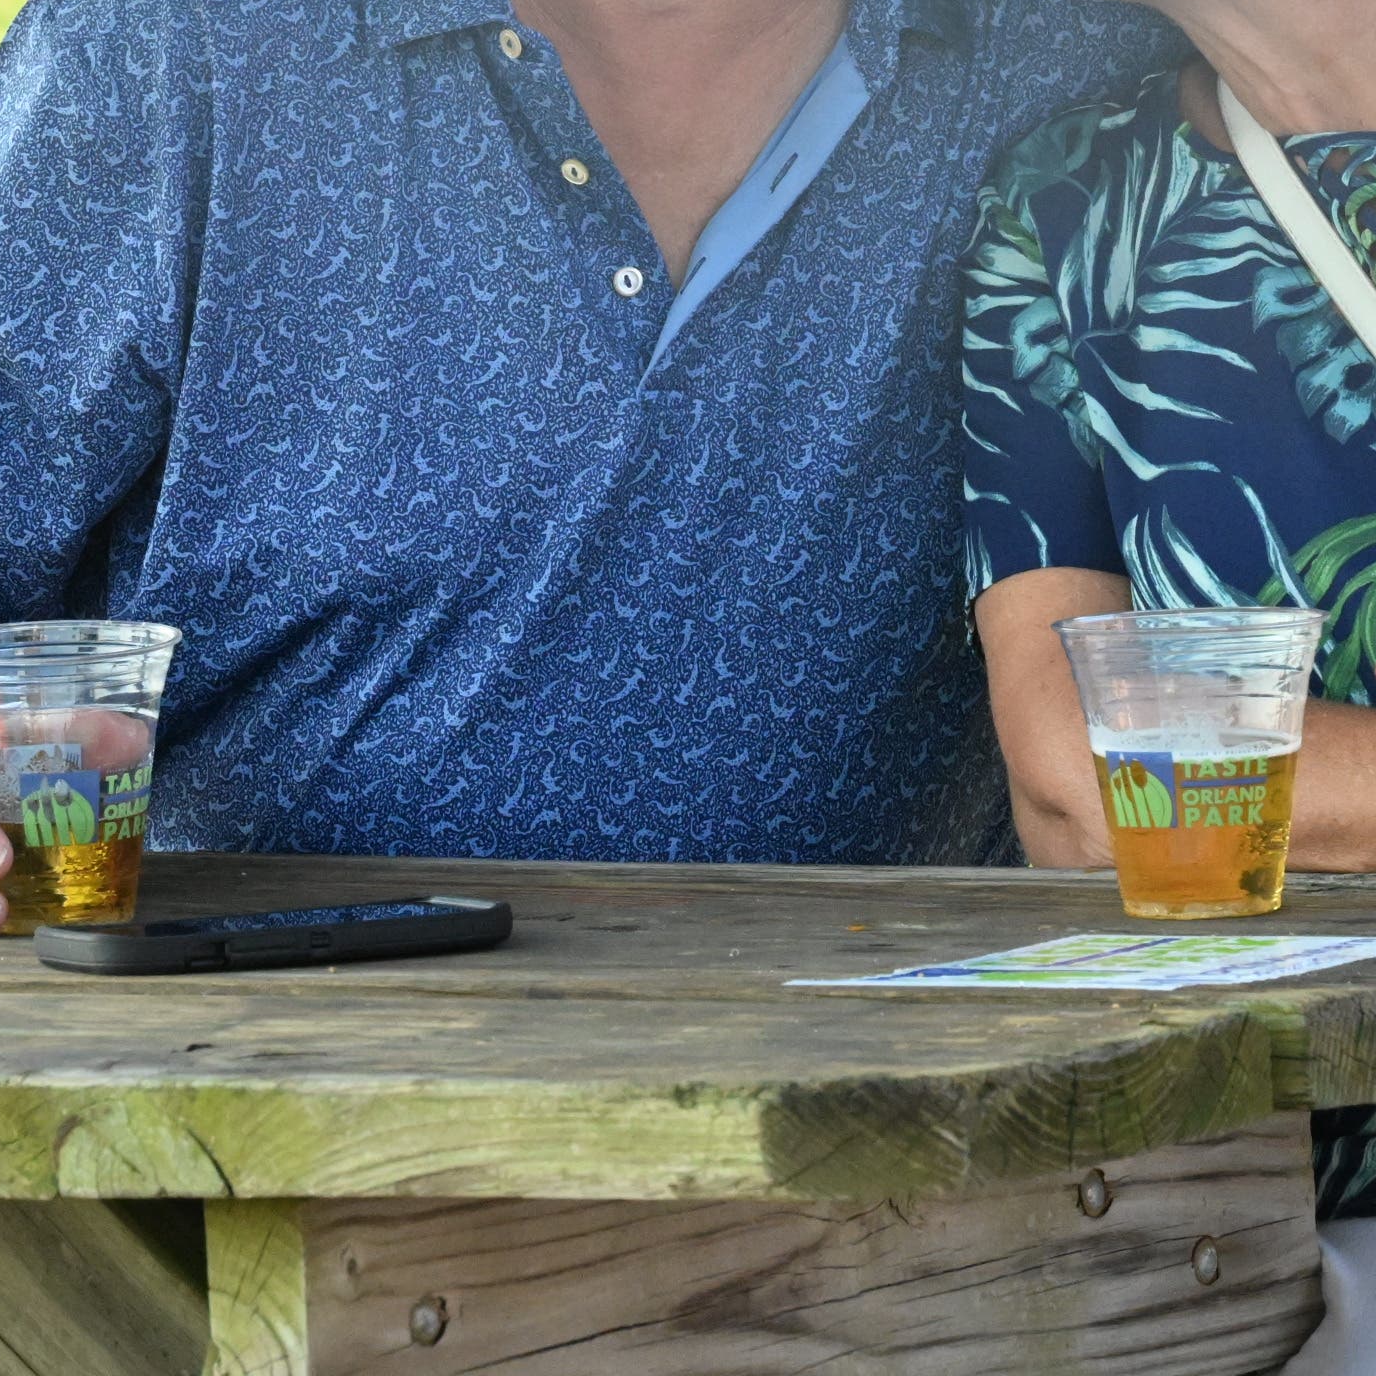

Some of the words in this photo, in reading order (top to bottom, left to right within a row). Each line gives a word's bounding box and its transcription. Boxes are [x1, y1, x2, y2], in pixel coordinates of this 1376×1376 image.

[1181, 755, 1269, 778] TASTE
[1182, 785, 1267, 806] ORLAND
[1184, 803, 1264, 828] PARK
[104, 815, 146, 843] PAR
